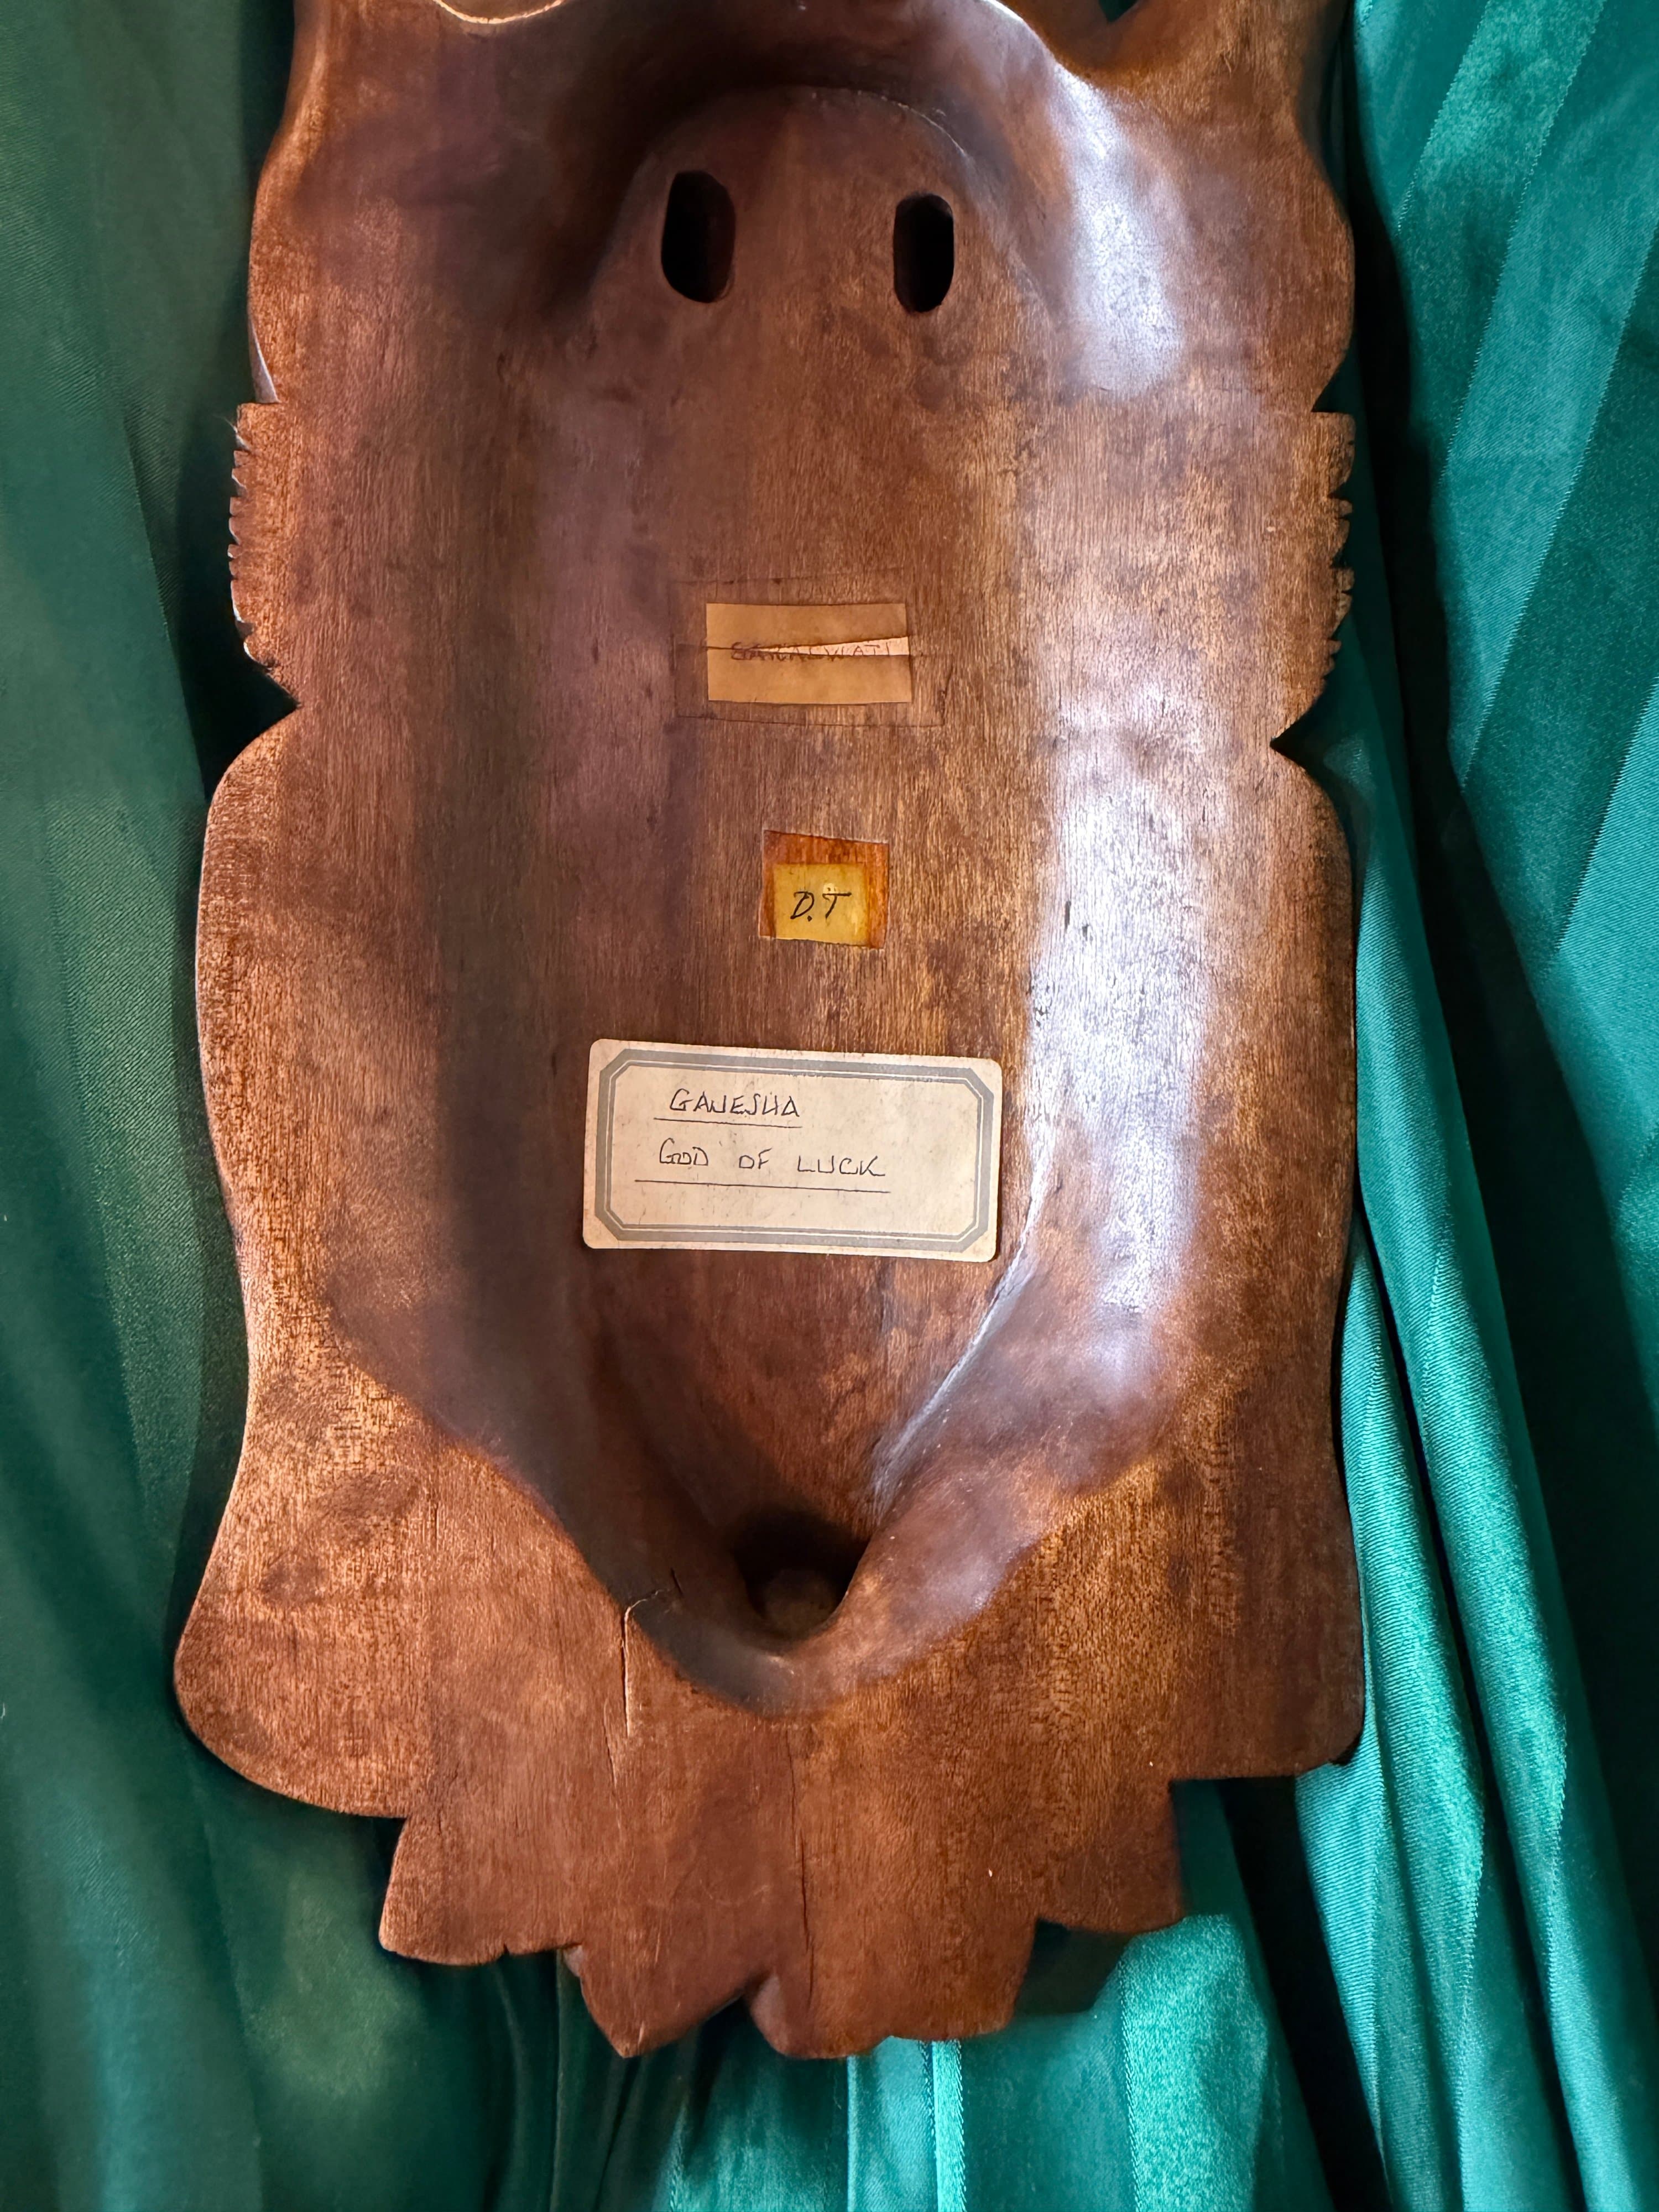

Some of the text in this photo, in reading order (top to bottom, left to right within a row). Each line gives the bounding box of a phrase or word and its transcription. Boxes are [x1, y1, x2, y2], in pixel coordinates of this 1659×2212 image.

[669, 1088, 800, 1118] GANESHA
[659, 1137, 885, 1177] GOD OF LUCK
